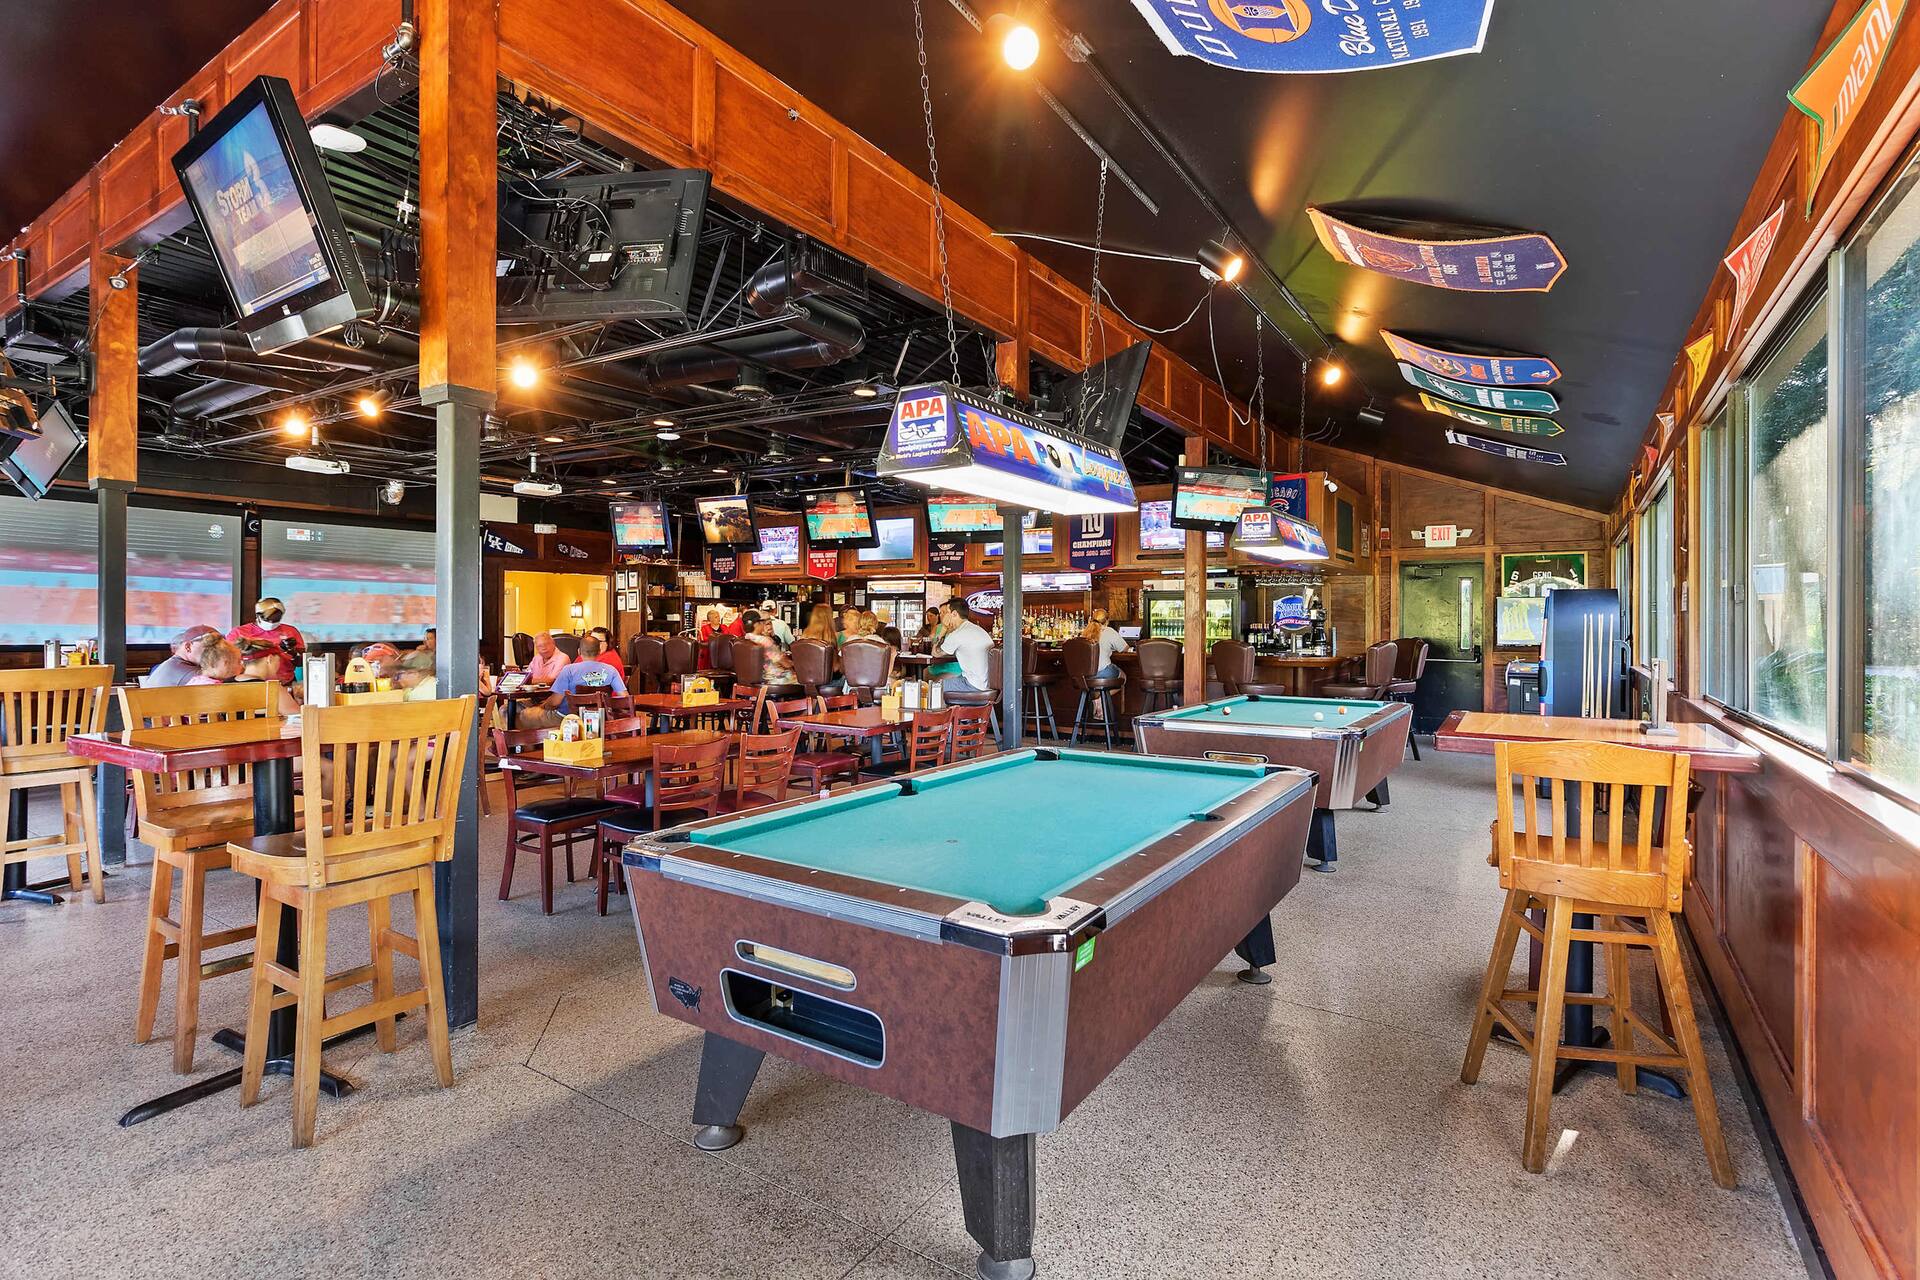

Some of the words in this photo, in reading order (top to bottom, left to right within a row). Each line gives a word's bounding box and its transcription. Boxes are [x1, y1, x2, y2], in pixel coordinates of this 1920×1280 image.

[1167, 0, 1238, 60] DU
[1339, 14, 1376, 57] Blue
[1377, 8, 1411, 60] NATIONAL
[1410, 19, 1430, 39] 1991
[216, 176, 254, 217] STORM
[900, 397, 944, 420] APA
[953, 391, 1002, 416] AMERICAN
[965, 410, 1037, 465] APA
[1243, 513, 1270, 523] APA
[1072, 539, 1112, 549] CHAMPIONS
[1431, 527, 1451, 541] EXIT
[1532, 570, 1552, 579] GENO
[1055, 903, 1082, 922] VALLEY
